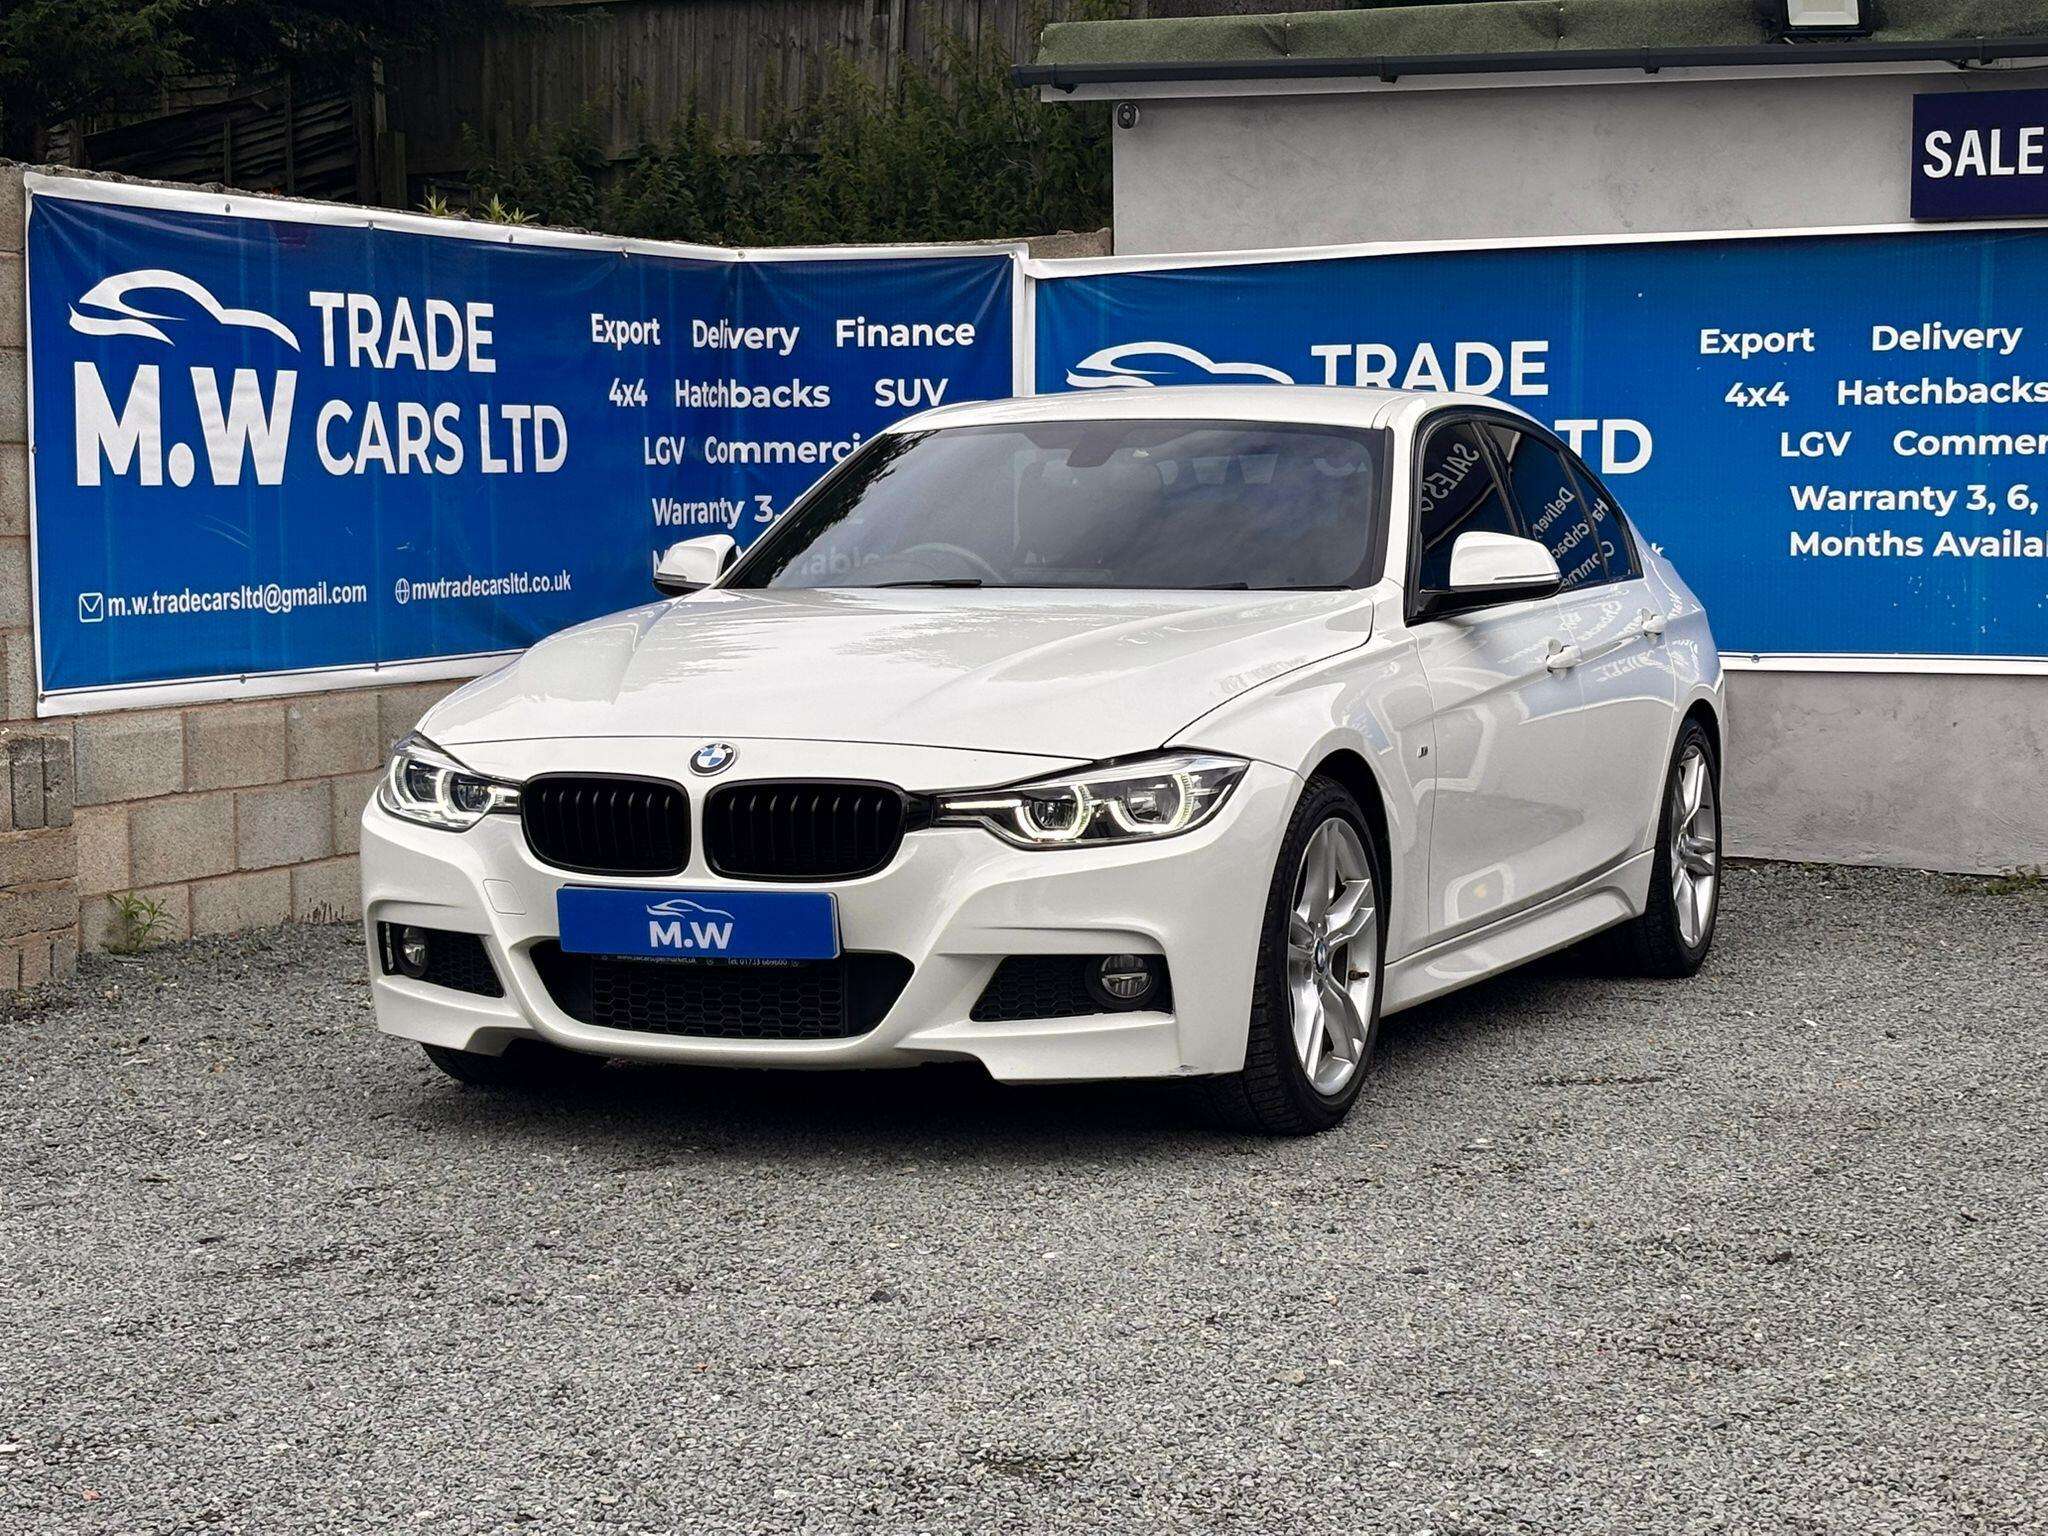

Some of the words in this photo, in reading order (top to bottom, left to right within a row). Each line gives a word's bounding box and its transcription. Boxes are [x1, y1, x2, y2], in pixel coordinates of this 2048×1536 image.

[1923, 127, 2044, 178] SALE
[310, 291, 496, 372] TRADE
[591, 314, 660, 350] Export
[693, 319, 799, 355] Delivery
[837, 316, 975, 347] Finance
[1701, 328, 1815, 359] Export
[1873, 322, 2023, 354] Delivery
[1310, 340, 1549, 397] TRADE
[609, 378, 647, 406] 4x4
[676, 379, 830, 408] Hatchbacks
[875, 379, 949, 408] SUV
[1725, 382, 1789, 407] 4x4
[1838, 376, 2048, 405] Hatchbacks
[74, 362, 297, 487] M.W
[317, 400, 463, 475] CARS
[480, 404, 567, 473] LTD
[645, 437, 685, 465] LGV
[704, 432, 860, 464] Commerci
[1554, 419, 1652, 473] TD
[1781, 432, 1851, 457] LGV
[1894, 430, 2048, 455] Commer
[652, 498, 745, 529] Warranty
[1790, 486, 1957, 516] Warranty
[1967, 485, 1996, 515] 3,
[2007, 484, 2038, 515] 6,
[1791, 530, 1923, 556] Months
[1933, 529, 2048, 557] Availa
[108, 582, 366, 616] m.w.tradecarsltd@gmail.com
[413, 570, 571, 599] mwtradecarsltd.co.uk
[650, 921, 732, 949] M.W
